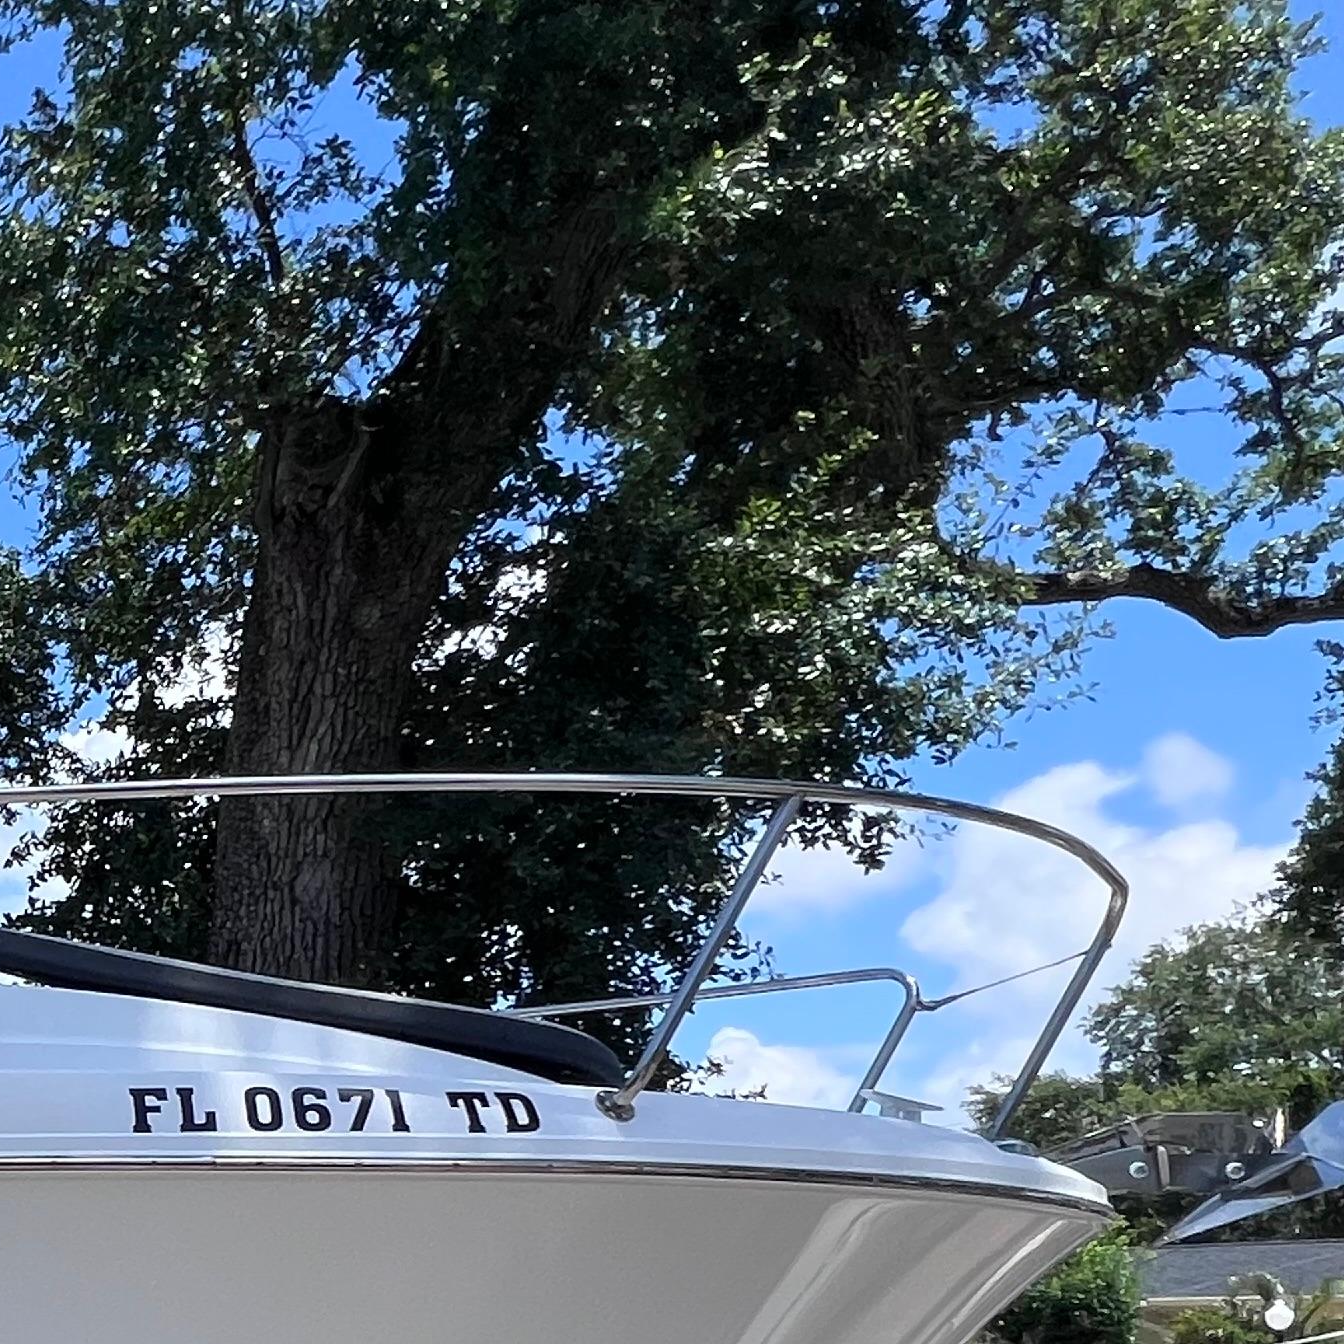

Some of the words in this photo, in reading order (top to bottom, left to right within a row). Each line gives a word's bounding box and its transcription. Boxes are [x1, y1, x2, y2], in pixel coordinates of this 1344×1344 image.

[127, 1087, 218, 1134] FL
[243, 1086, 411, 1133] 0671
[445, 1091, 541, 1134] TD
